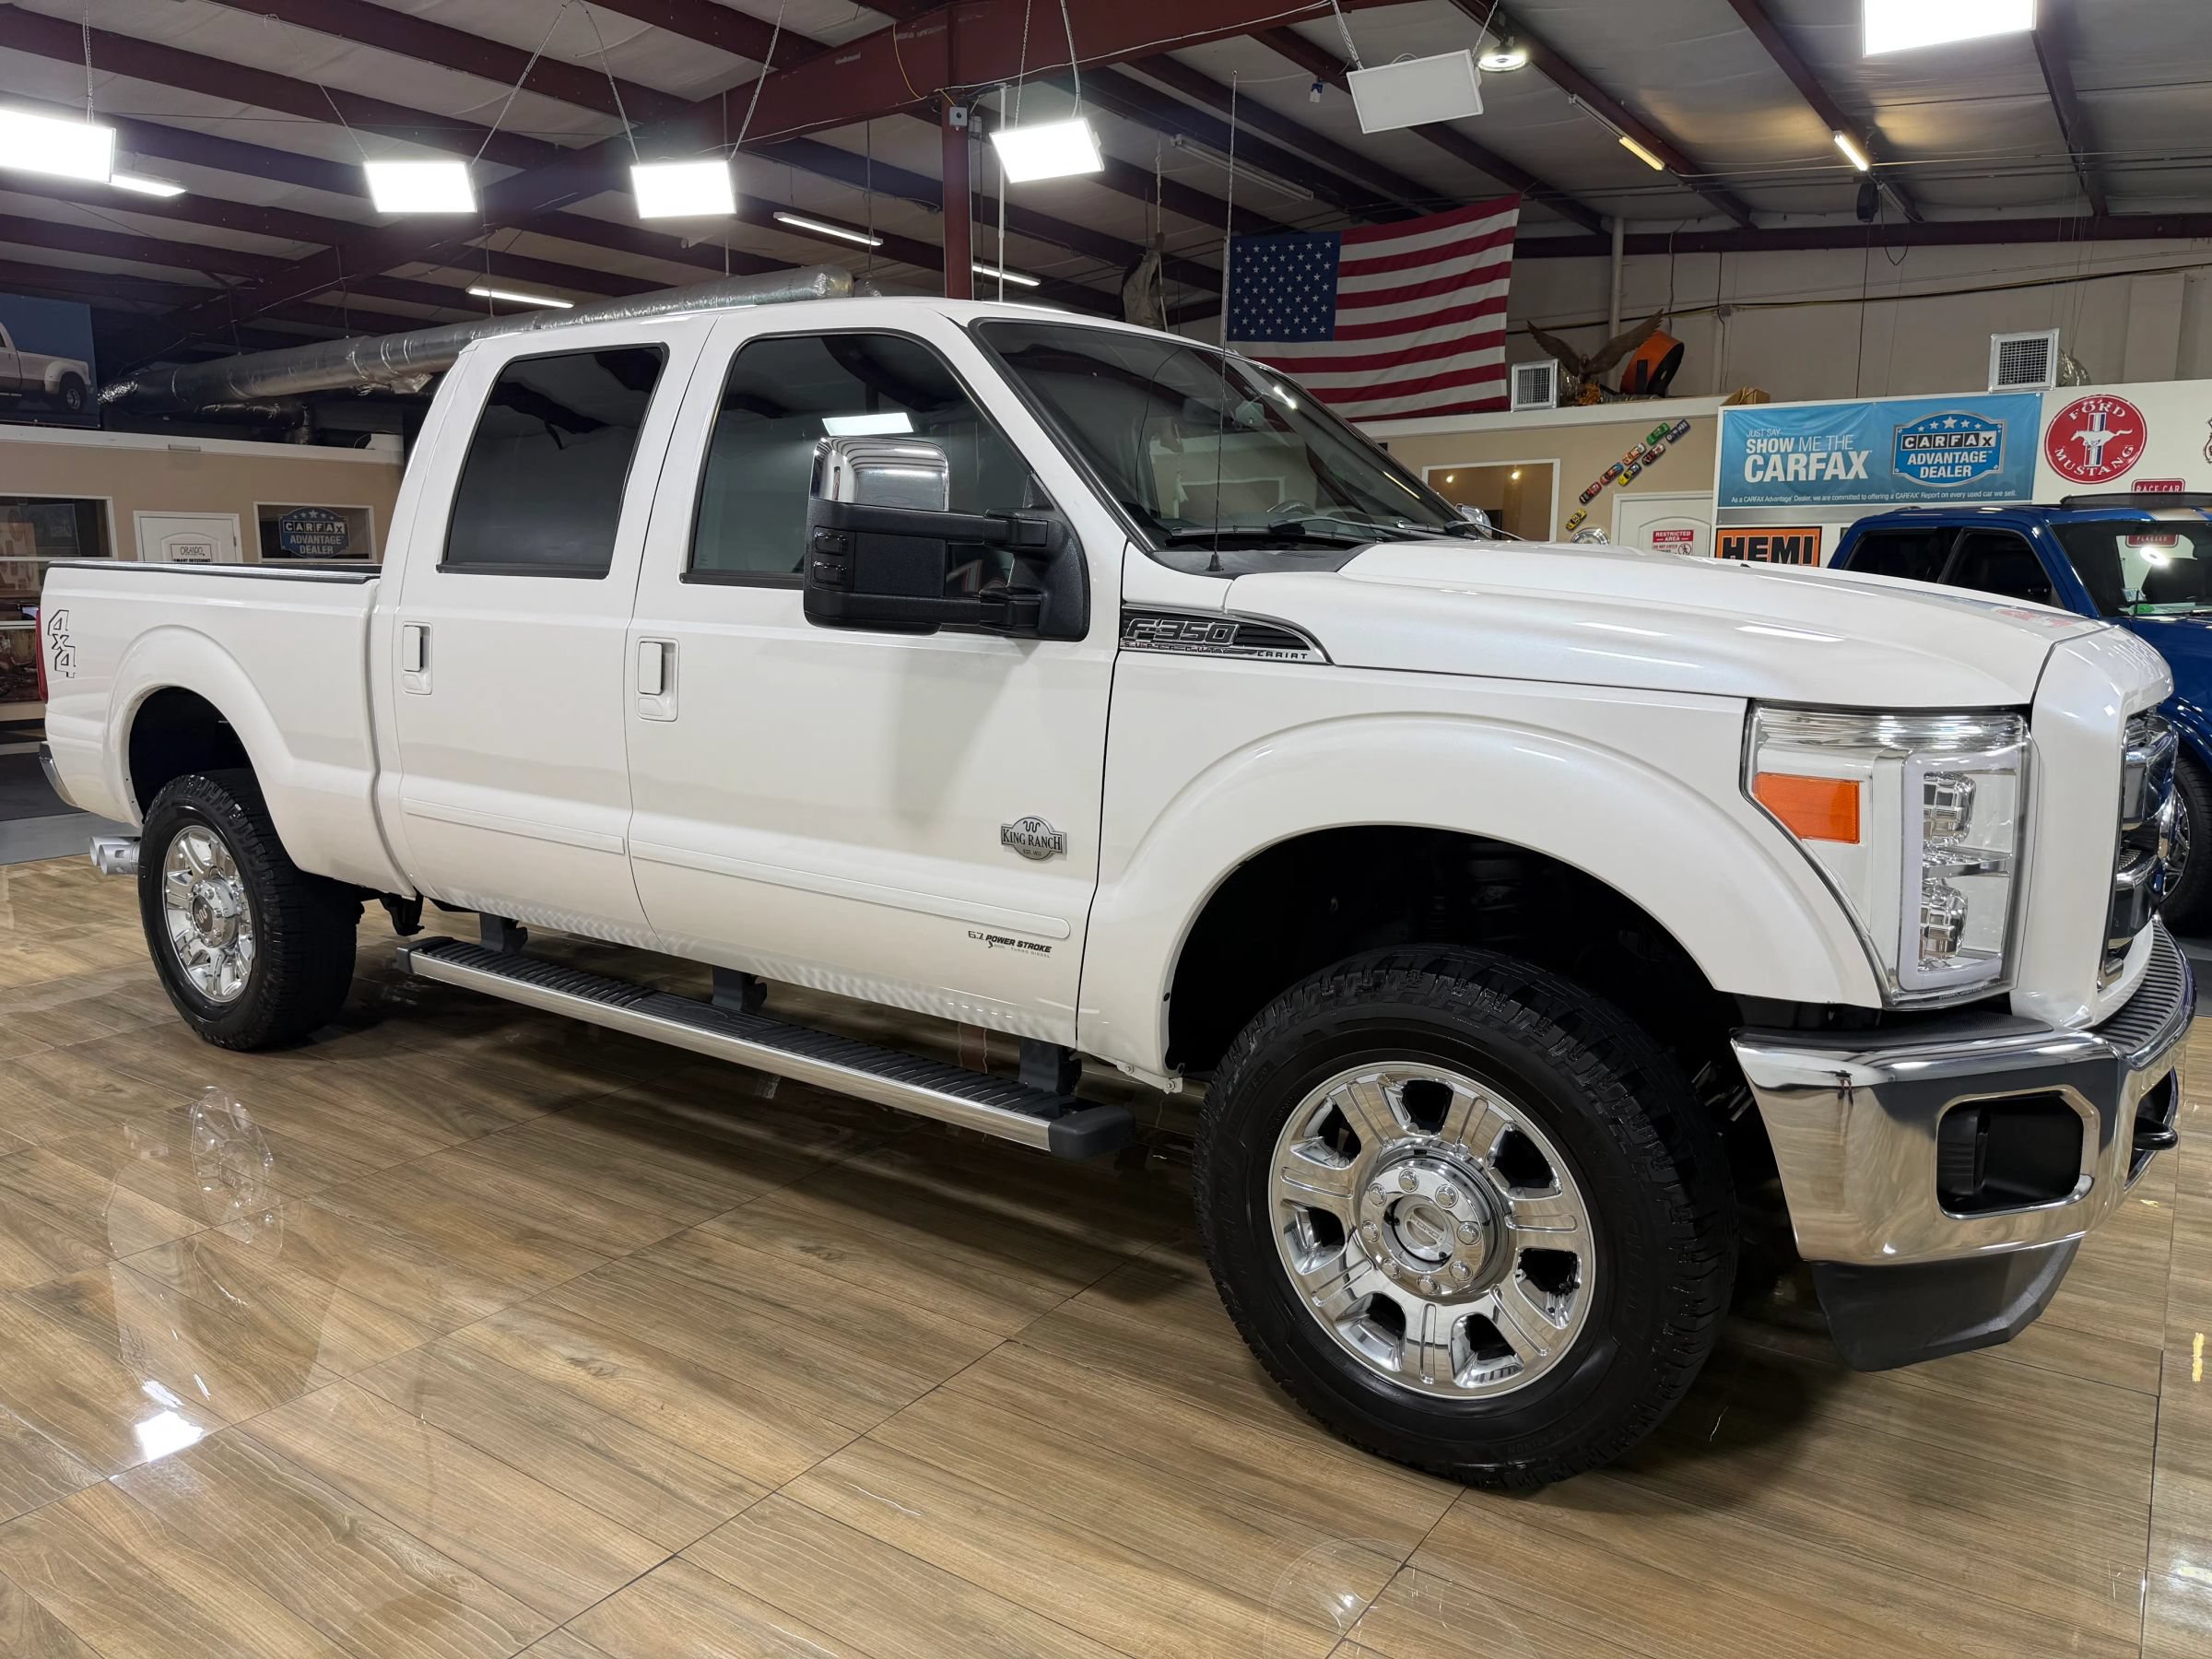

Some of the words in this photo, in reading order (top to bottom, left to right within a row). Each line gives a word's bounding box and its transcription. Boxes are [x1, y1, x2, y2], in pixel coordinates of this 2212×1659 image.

[2068, 402, 2126, 420] FORD
[1747, 438, 1794, 453] SHOW
[1799, 437, 1821, 452] ME
[1826, 434, 1854, 451] THE
[1904, 433, 1994, 448] CARFAX
[1907, 451, 1988, 465] ADVANTAGE
[2054, 444, 2135, 477] MUSTANG
[1744, 450, 1869, 483] CARFAX
[1920, 465, 1972, 478] DEALER
[1921, 491, 1940, 500] Report
[285, 521, 345, 533] CARFAX
[290, 535, 342, 545] ADVANTAGE
[300, 545, 334, 554] DEALER
[1722, 535, 1816, 566] HEMI
[1003, 829, 1026, 845] KING
[1028, 834, 1061, 851] RANCH
[985, 935, 1016, 946] POWER
[1017, 940, 1053, 953] STROKE
